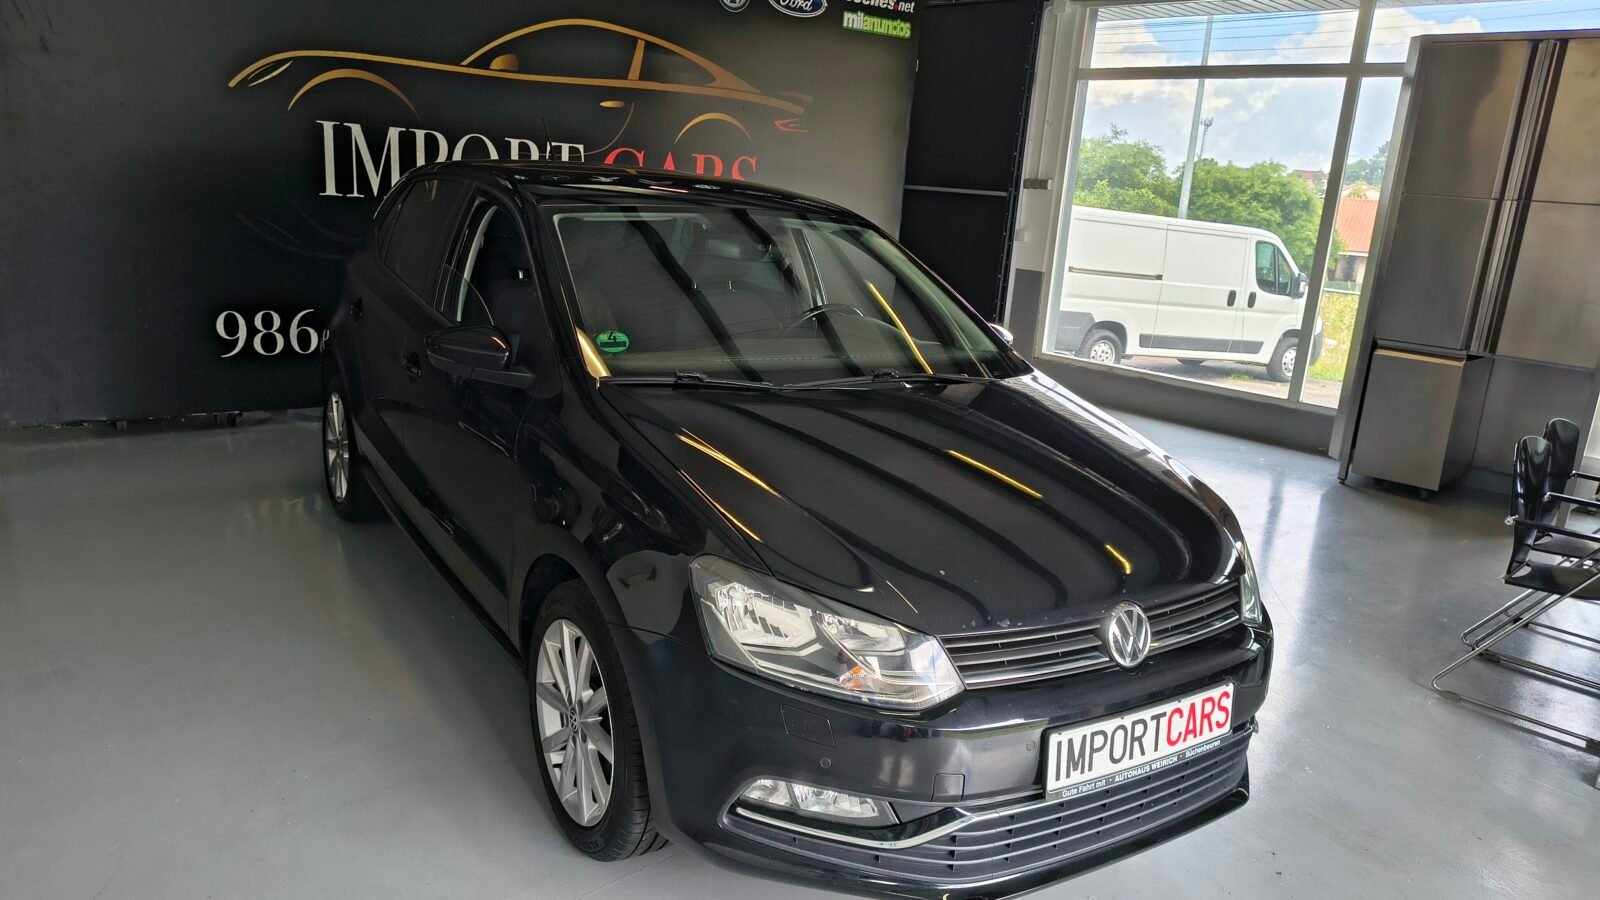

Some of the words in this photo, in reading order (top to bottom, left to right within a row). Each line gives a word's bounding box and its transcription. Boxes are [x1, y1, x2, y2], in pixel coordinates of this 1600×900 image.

[843, 10, 911, 38] milanuncios
[845, 0, 915, 13] es.net
[216, 309, 319, 358] 986
[1062, 788, 1078, 798] Gute
[1078, 782, 1095, 793] Fahrt
[1095, 779, 1106, 789] mit
[1114, 765, 1151, 782] AUTOHAUS
[1151, 756, 1178, 771] WEIRICH
